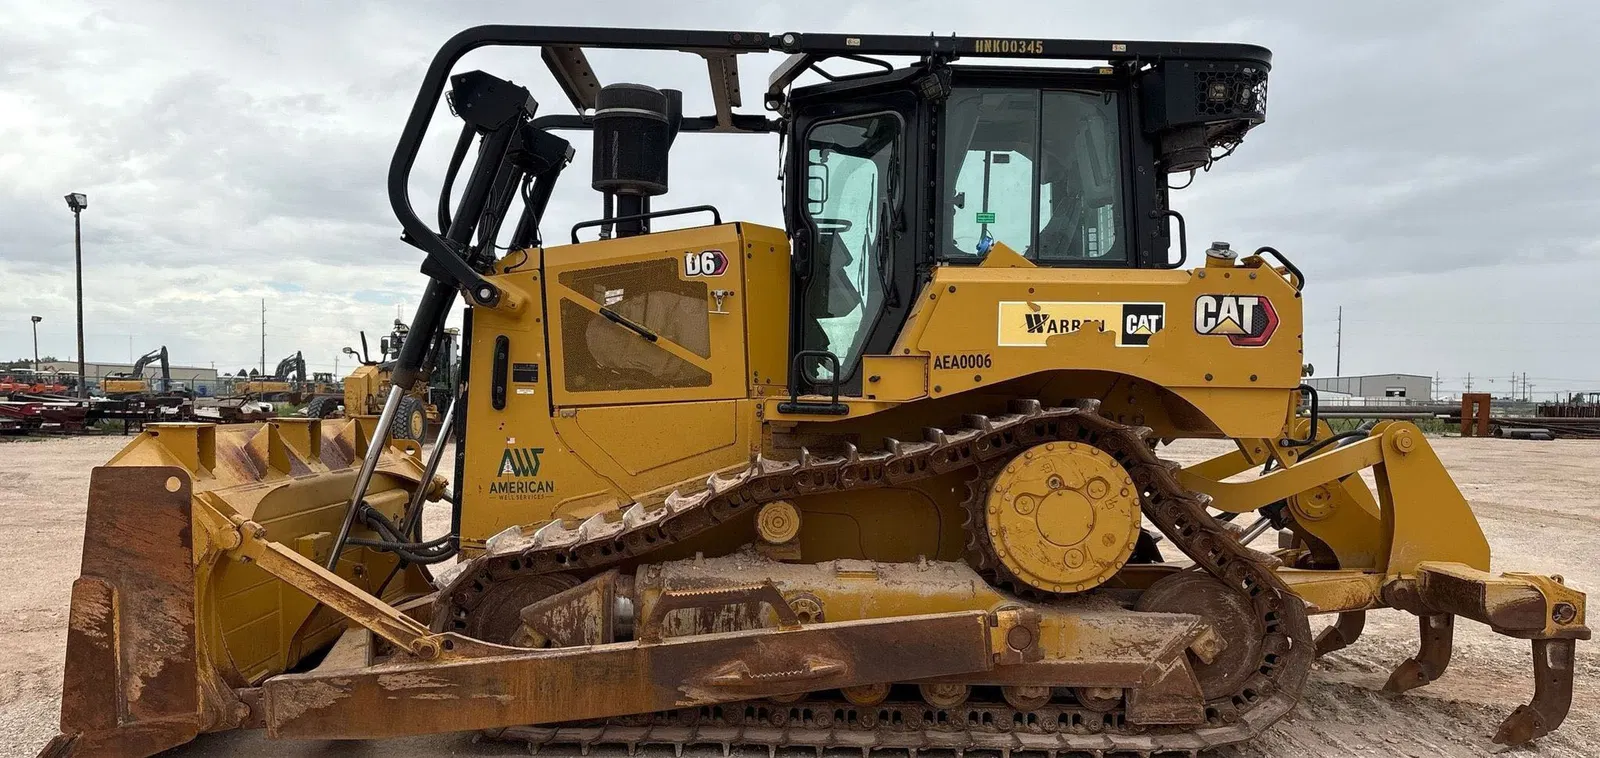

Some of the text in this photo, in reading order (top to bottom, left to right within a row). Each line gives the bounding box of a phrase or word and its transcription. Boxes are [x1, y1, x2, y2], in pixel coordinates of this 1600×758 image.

[975, 39, 1043, 54] HNK00345
[685, 251, 715, 275] D6
[1024, 313, 1105, 334] WARRN
[1126, 314, 1159, 334] CAT
[1196, 295, 1258, 334] CAT
[933, 353, 992, 370] AEA0006
[490, 481, 554, 493] AMERICAN
